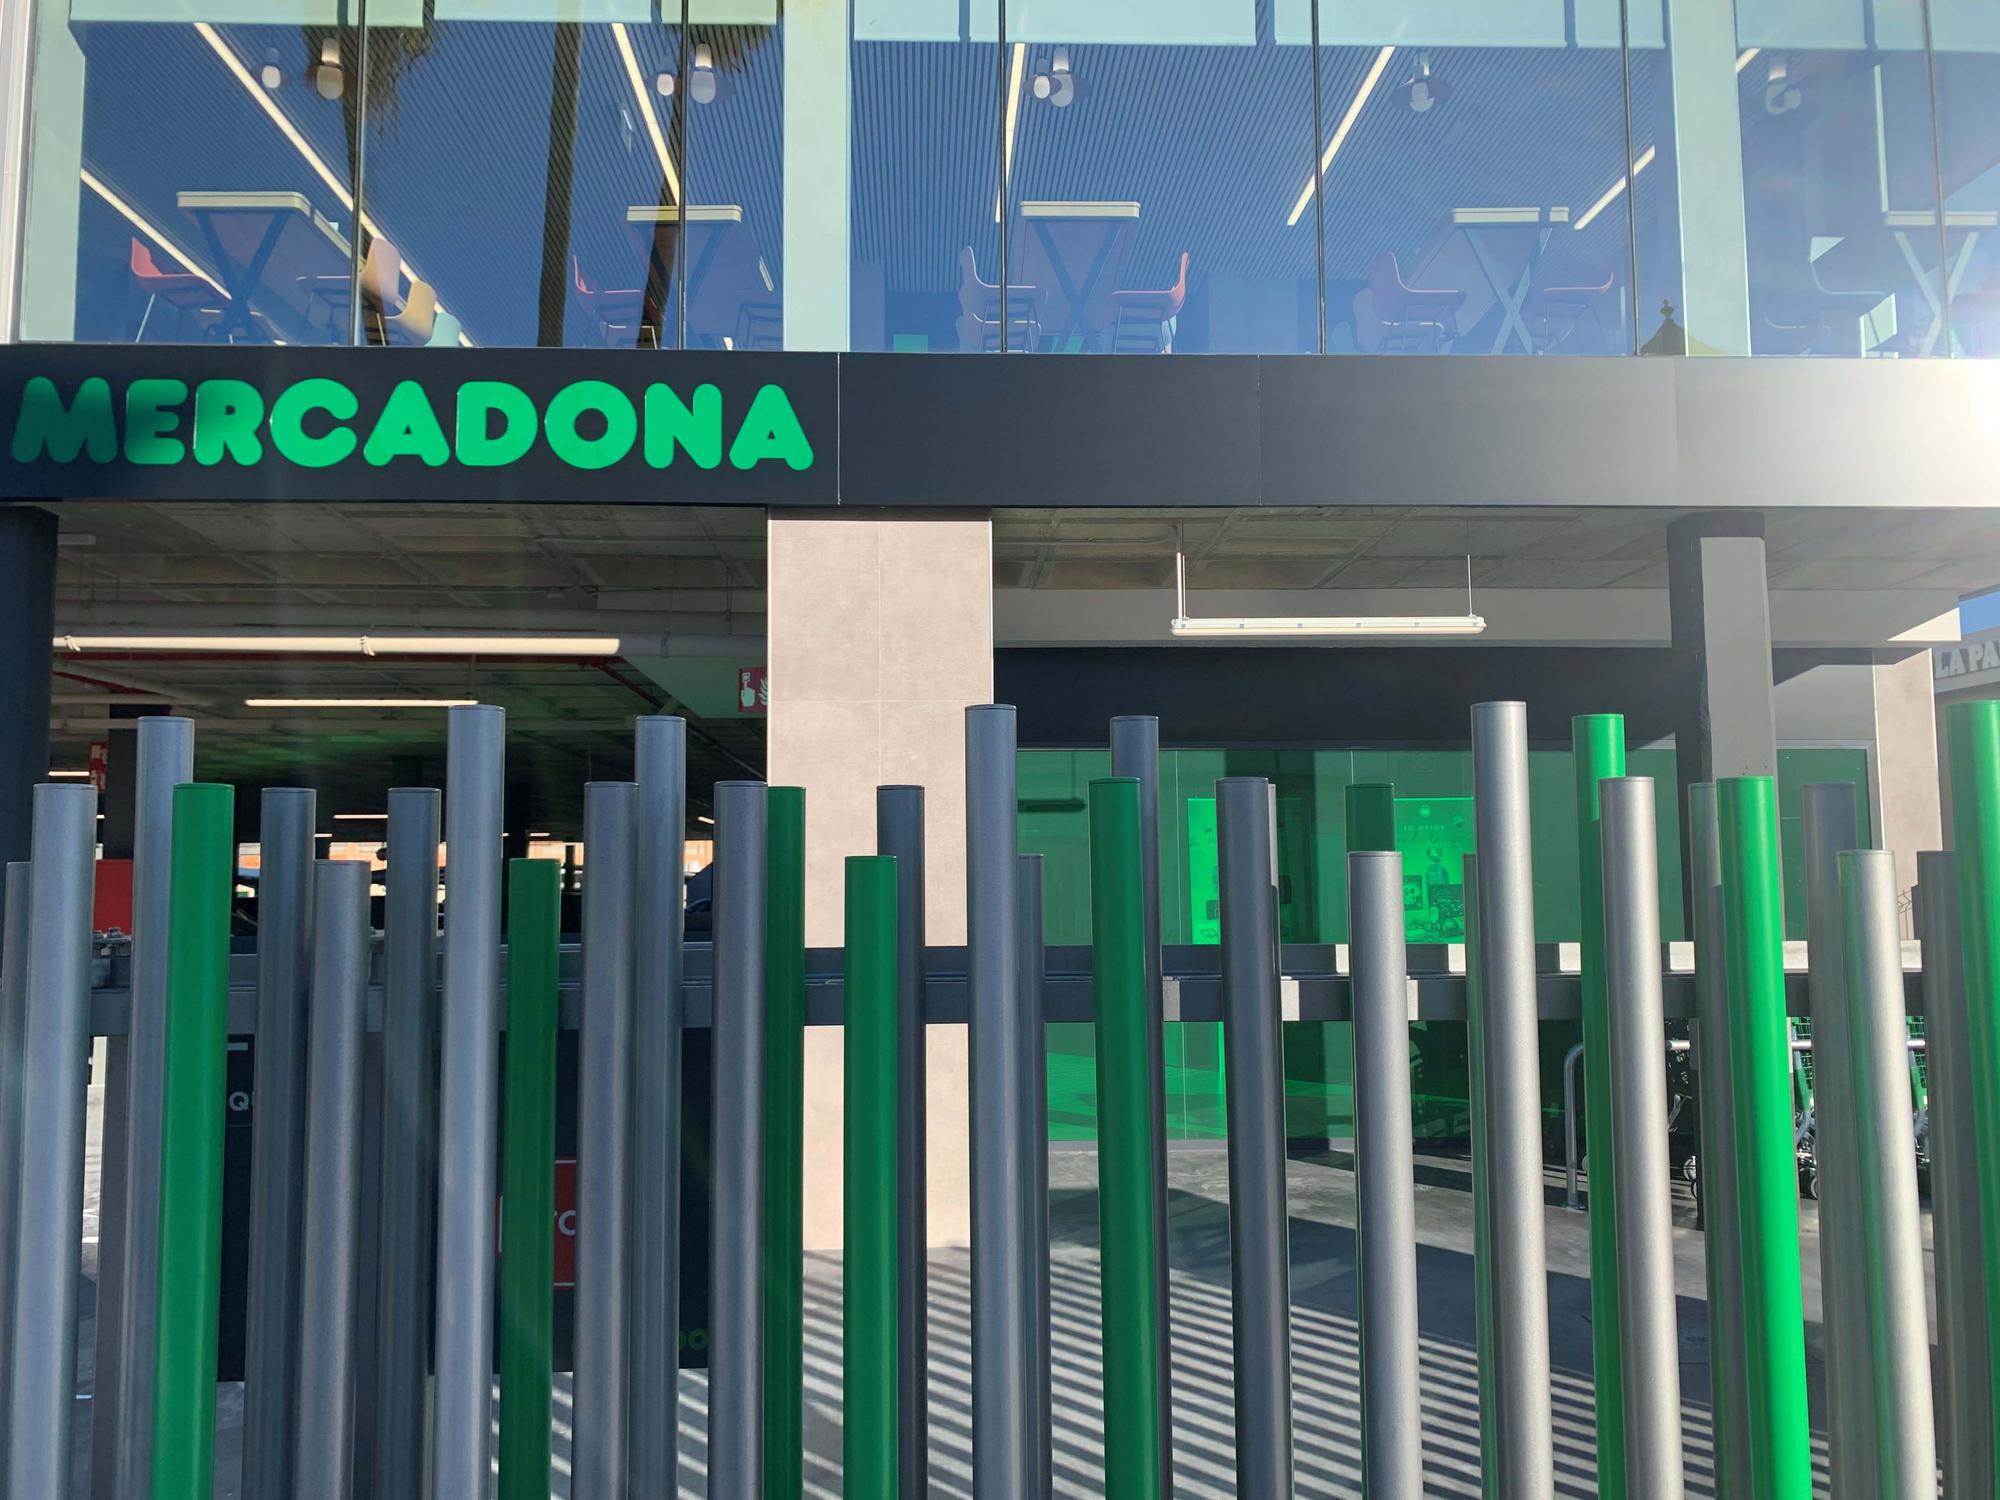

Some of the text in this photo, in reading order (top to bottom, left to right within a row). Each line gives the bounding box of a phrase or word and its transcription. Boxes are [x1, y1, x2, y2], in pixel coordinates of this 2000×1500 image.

[11, 376, 815, 471] MERCADONA
[1935, 639, 2000, 679] LA PA
